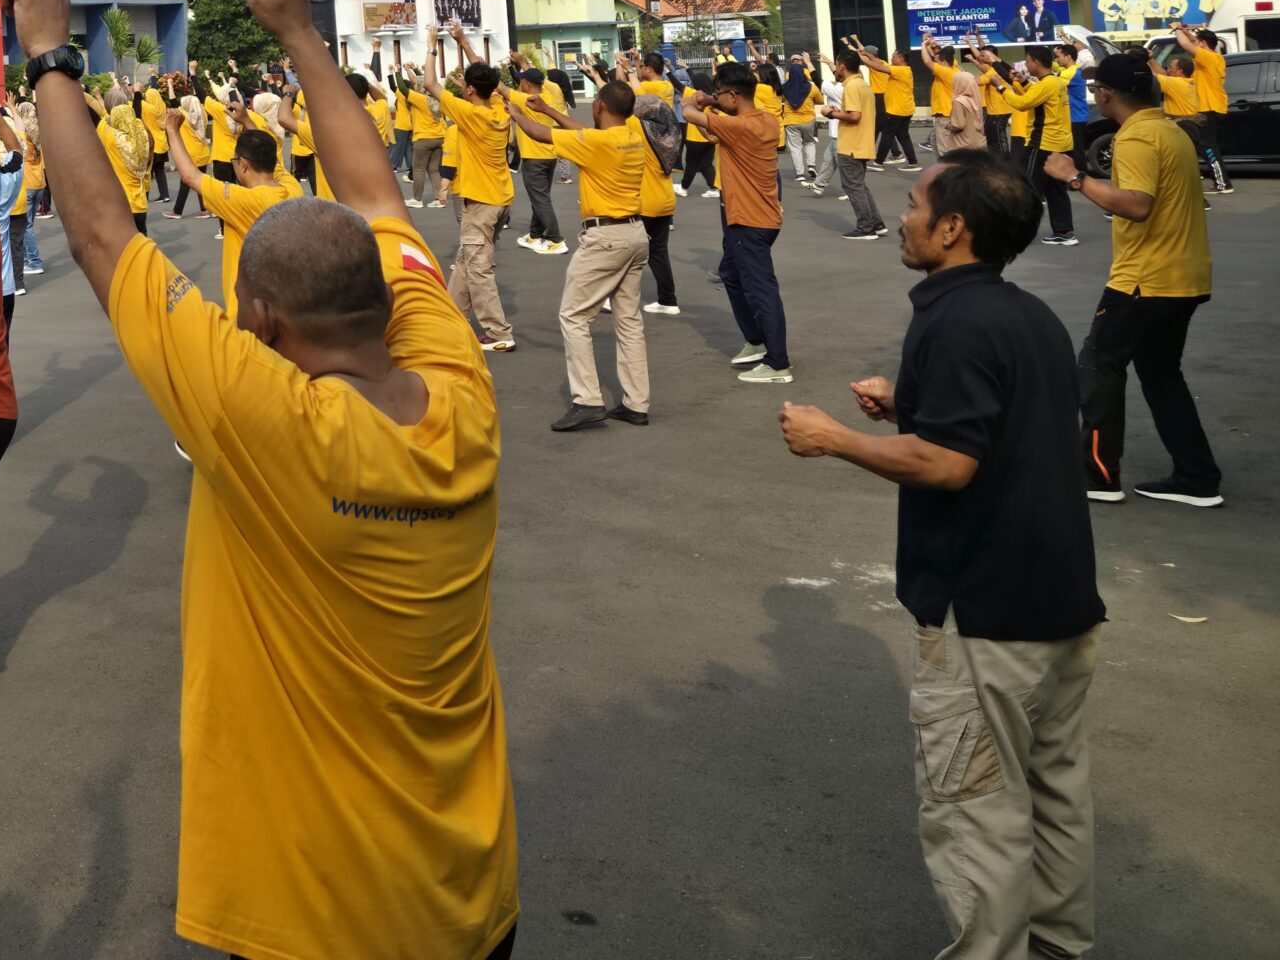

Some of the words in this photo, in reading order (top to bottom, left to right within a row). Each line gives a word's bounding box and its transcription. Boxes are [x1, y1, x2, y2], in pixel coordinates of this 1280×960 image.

[917, 8, 957, 17] INTERNET
[959, 7, 996, 15] JAGOAN
[924, 15, 945, 23] BUAT
[955, 13, 990, 21] KANTOR
